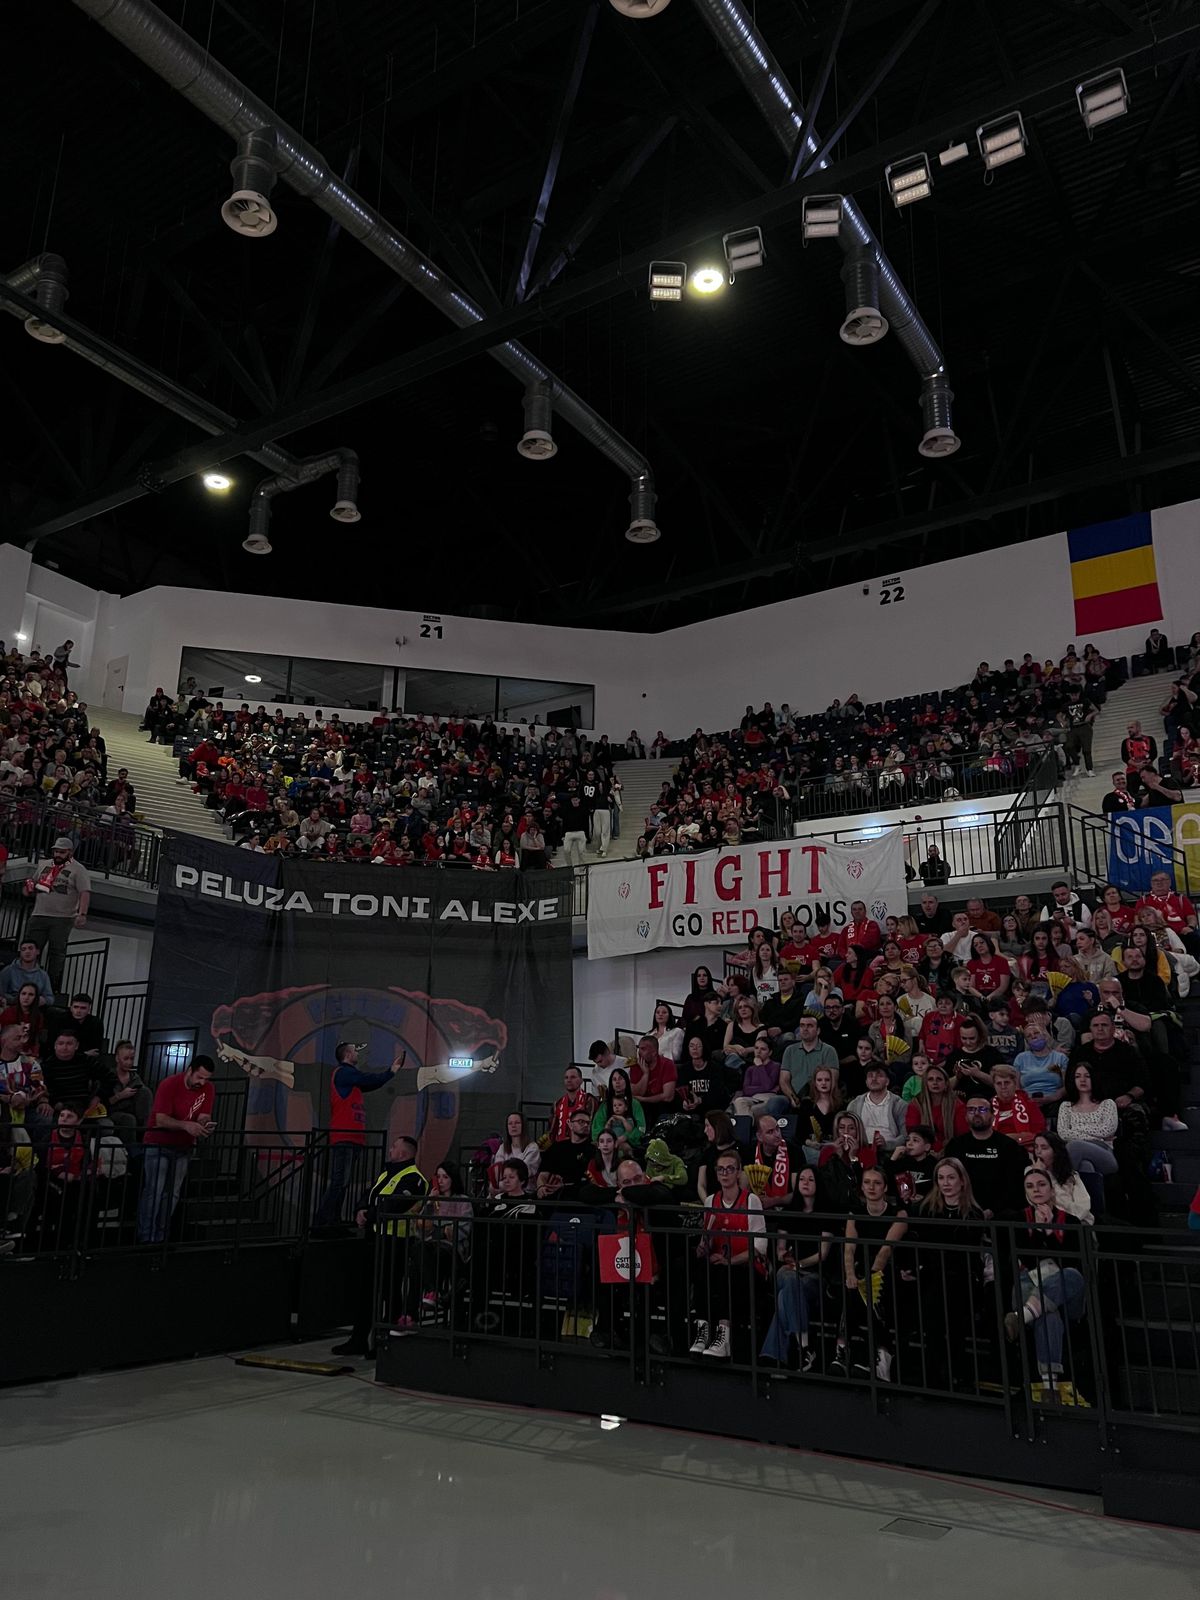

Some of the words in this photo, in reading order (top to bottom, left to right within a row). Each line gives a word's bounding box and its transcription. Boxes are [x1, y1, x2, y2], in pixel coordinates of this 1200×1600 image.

[880, 587, 905, 605] 22
[420, 624, 443, 639] 21
[175, 864, 314, 913] PELUZA
[323, 892, 430, 918] TONI
[439, 897, 559, 924] ALEXE
[647, 845, 827, 909] FIGHT
[672, 912, 702, 937] GO
[712, 909, 758, 934] RED
[773, 900, 847, 930] LONS
[774, 1145, 788, 1188] CSM
